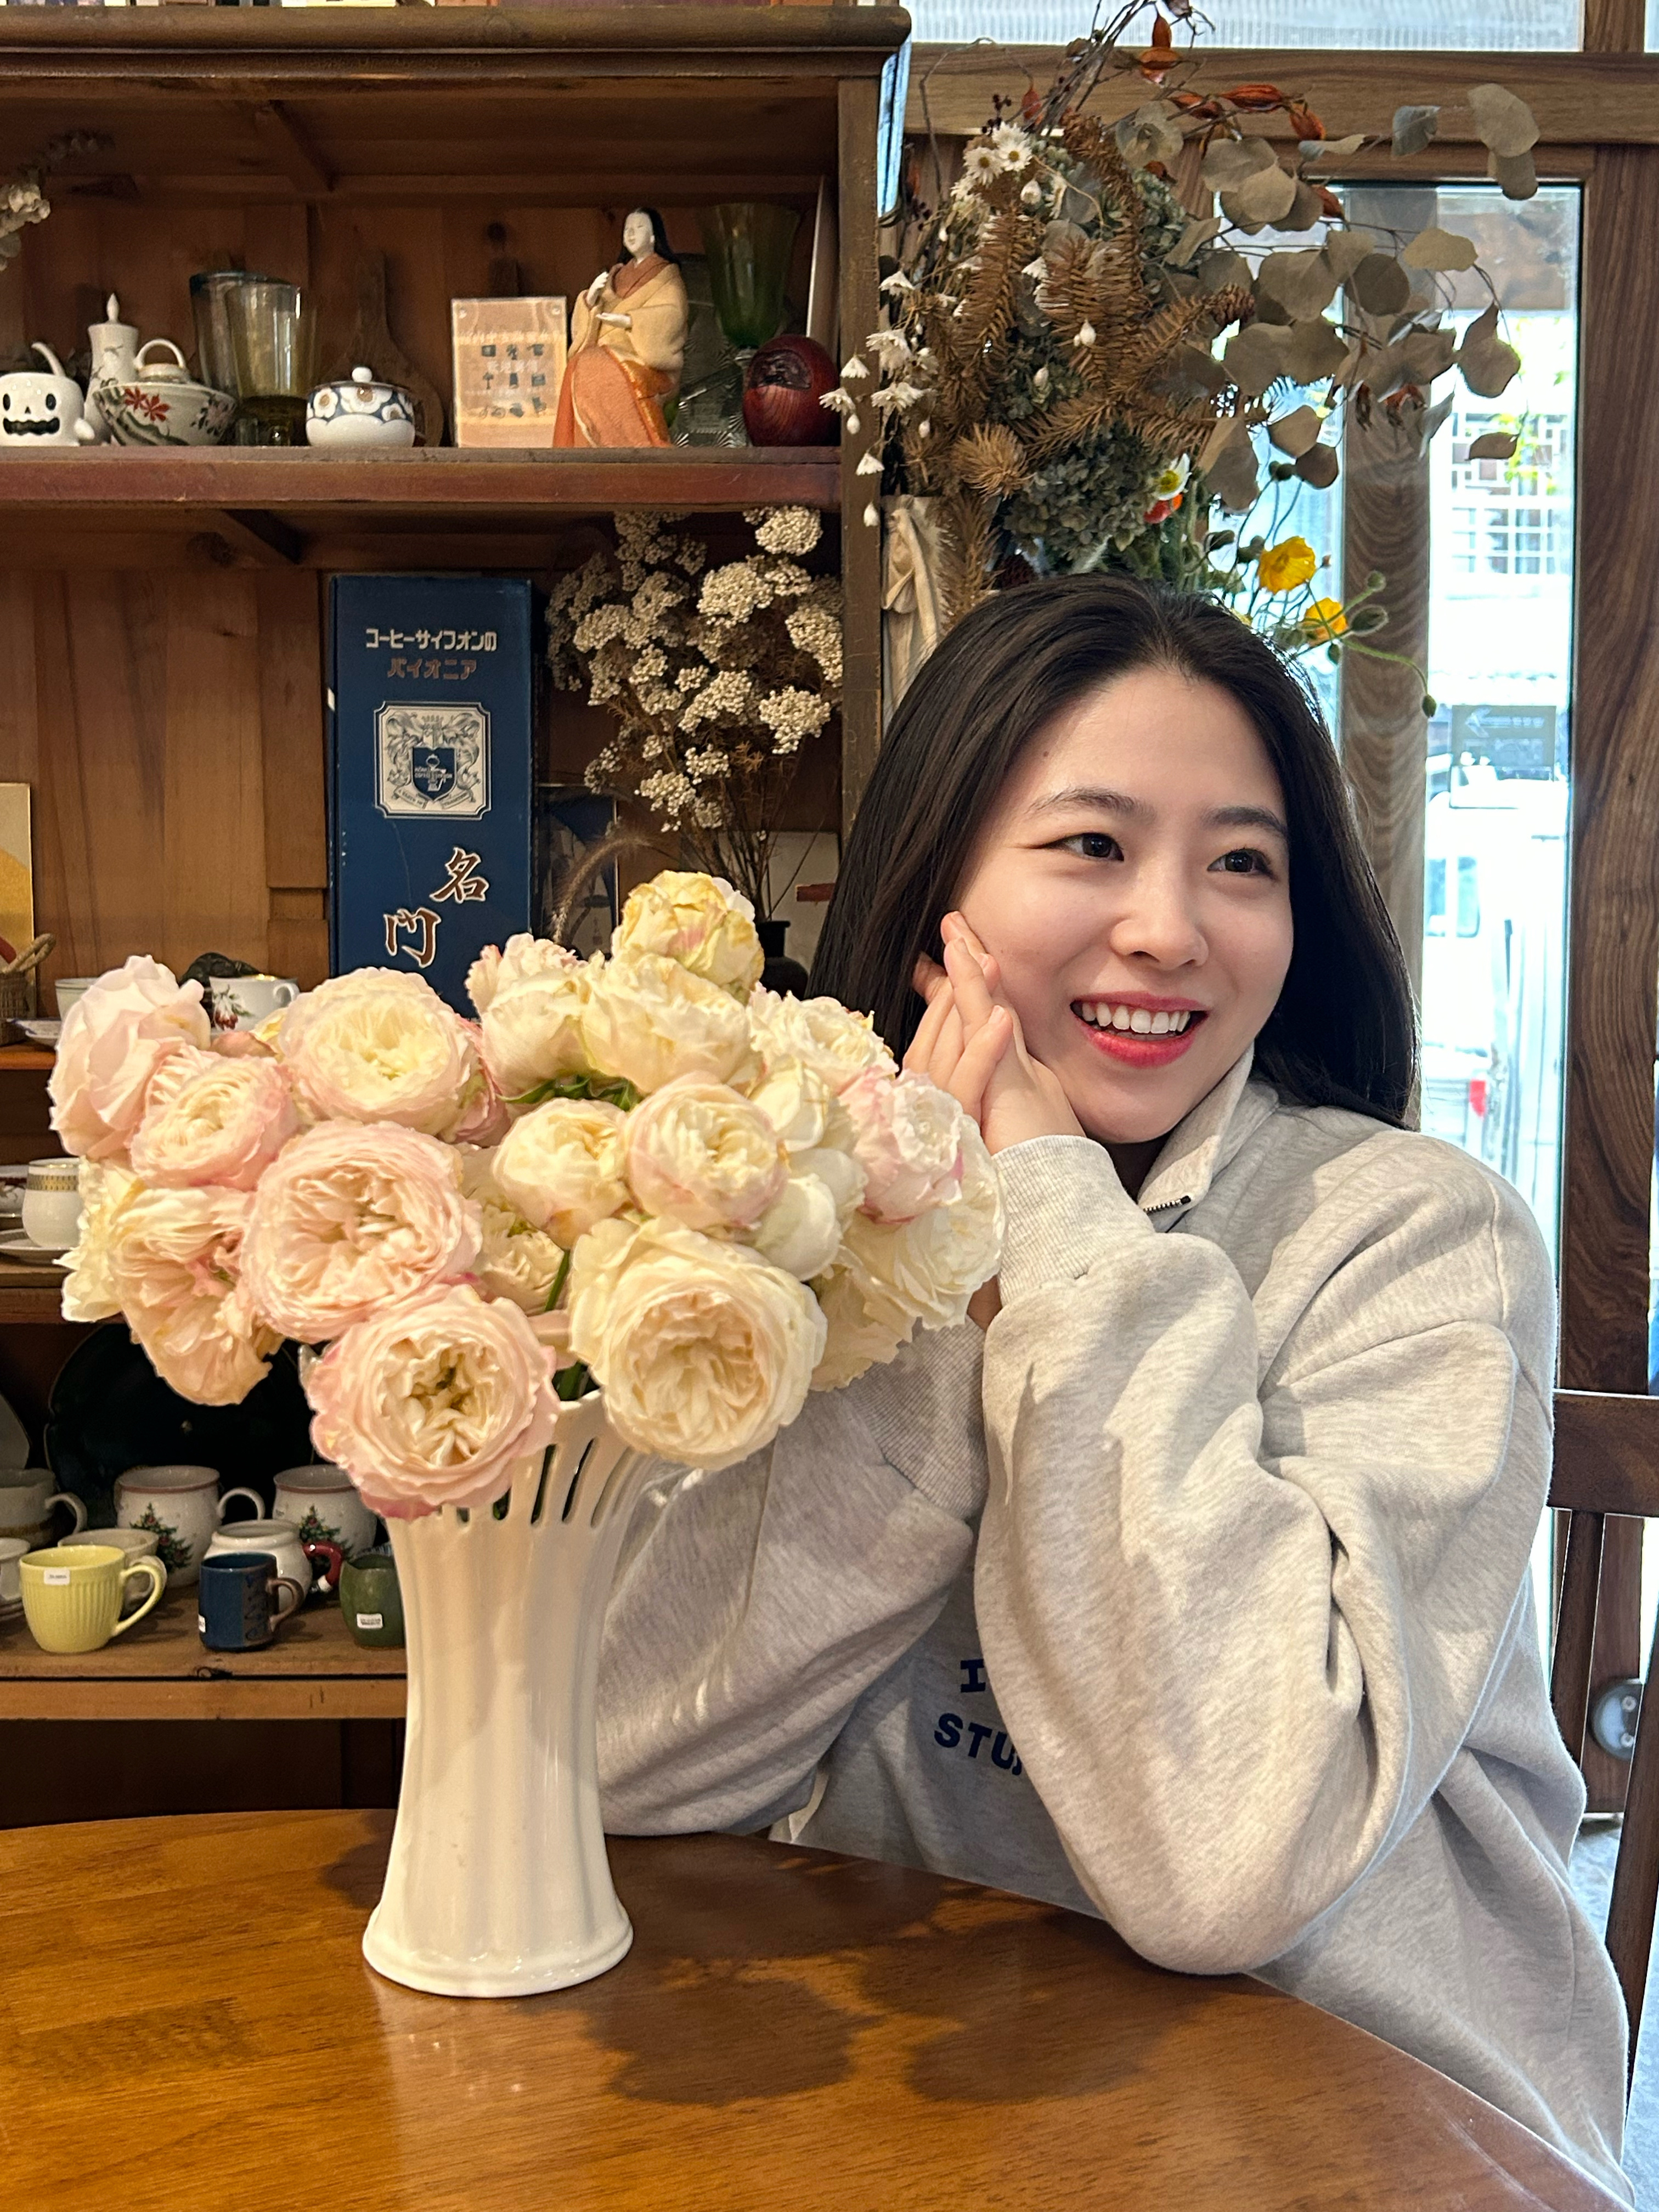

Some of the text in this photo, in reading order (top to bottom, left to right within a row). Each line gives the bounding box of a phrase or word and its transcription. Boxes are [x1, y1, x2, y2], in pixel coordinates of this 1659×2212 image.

[387, 657, 477, 680] パイオニア
[934, 1713, 1022, 1776] STU
